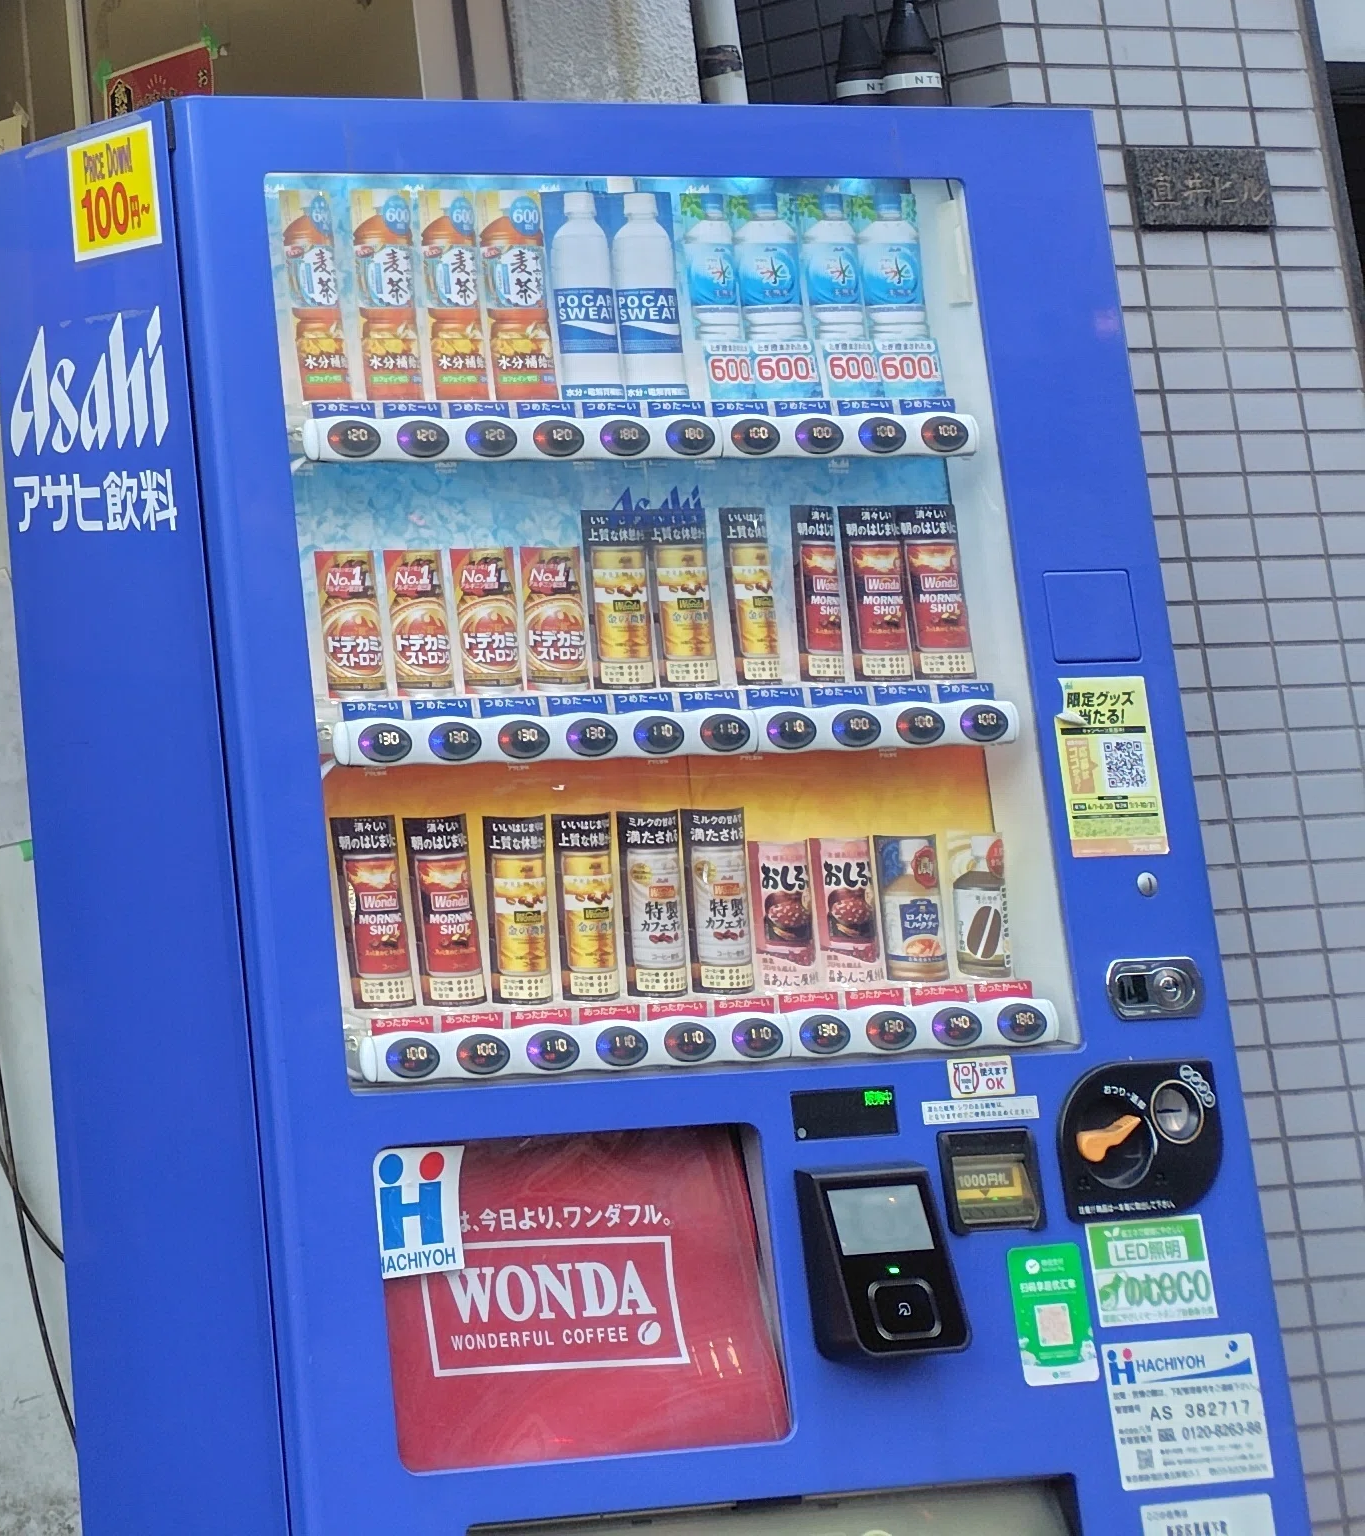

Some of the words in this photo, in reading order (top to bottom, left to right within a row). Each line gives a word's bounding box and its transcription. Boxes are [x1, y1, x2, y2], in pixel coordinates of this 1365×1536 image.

[82, 149, 105, 186] PRICE
[512, 208, 539, 225] 600
[382, 249, 409, 304] 麦茶
[509, 249, 540, 305] 麦茶
[558, 307, 614, 321] SWEAT
[619, 307, 676, 321] SWEAT
[710, 357, 751, 382] 600
[756, 356, 811, 381] 600
[828, 355, 876, 381] 600
[878, 355, 933, 381] 600
[10, 305, 170, 458] Asahi
[13, 468, 178, 533] アサヒ飲料
[325, 565, 362, 586] No.1
[394, 565, 430, 586] No.1
[461, 563, 498, 583] No.1
[530, 562, 566, 582] No.1
[868, 577, 900, 591] Wonda
[923, 575, 957, 590] Wonda
[873, 604, 901, 615] SHOT
[929, 602, 959, 613] SHOT
[1066, 690, 1136, 709] 限定グッズ
[363, 895, 397, 909] Wonda
[434, 894, 469, 908] Wonda
[644, 899, 679, 921] 特製
[709, 897, 745, 919] 特製
[369, 924, 399, 936] SHOT
[440, 922, 470, 934] SHOT
[979, 1066, 1009, 1077] 使えます
[985, 1076, 1006, 1091] OK
[958, 1171, 1010, 1188] 1000円札
[1114, 1239, 1182, 1262] LED照明
[443, 1259, 657, 1325] WONDA
[450, 1330, 555, 1352] WONDERFUL
[562, 1325, 629, 1347] COFFEE
[1135, 1354, 1206, 1374] HACHIYOH
[1150, 1405, 1173, 1422] AS
[1184, 1398, 1251, 1419] 382717
